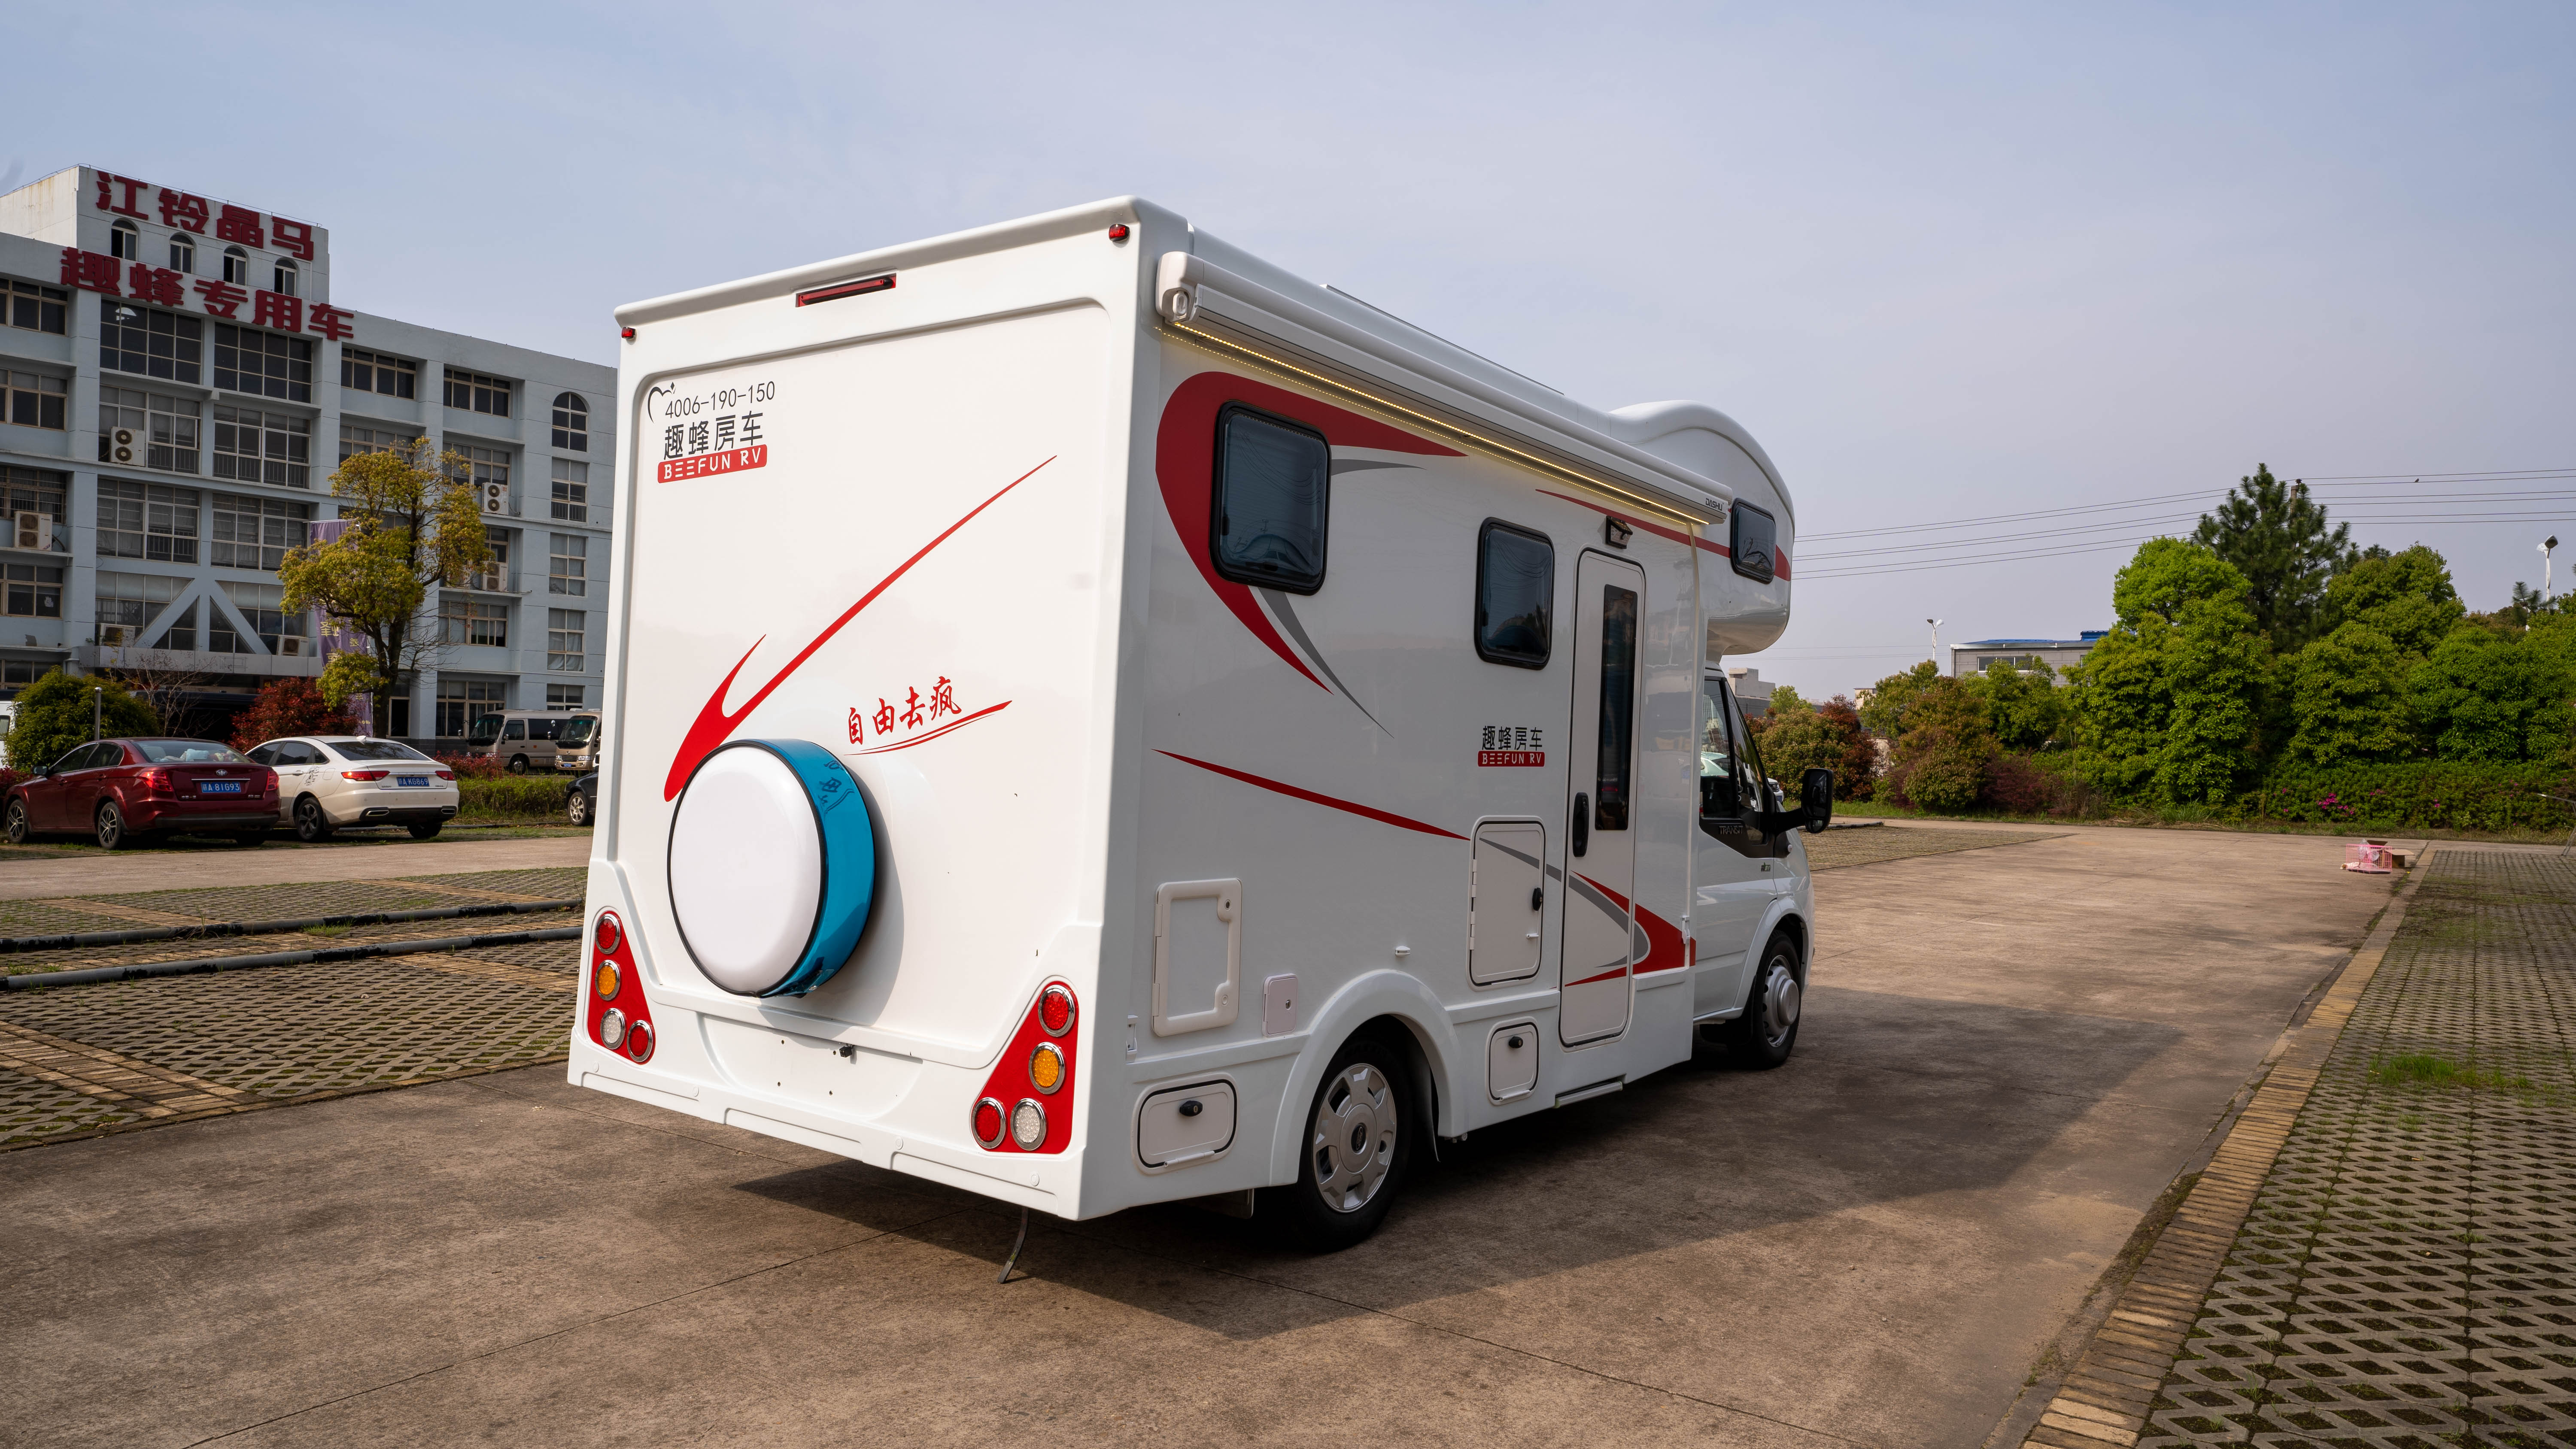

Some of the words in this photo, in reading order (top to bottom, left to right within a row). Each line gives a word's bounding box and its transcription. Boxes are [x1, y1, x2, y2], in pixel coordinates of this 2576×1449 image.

[96, 171, 314, 261] 江铃晶马
[61, 246, 354, 341] 趣蜂专用车
[665, 381, 775, 418] 4006-190-150
[664, 410, 763, 460] 趣蜂房车
[664, 453, 730, 479] BEEFUN
[740, 447, 761, 466] RV
[1705, 498, 1722, 511] DASHU
[848, 676, 962, 745] 自由去疯
[1482, 725, 1543, 751] 趣蜂房车
[1482, 753, 1524, 764] BEEFUN
[1530, 753, 1542, 764] RV
[1719, 826, 1744, 835] TRANSIT
